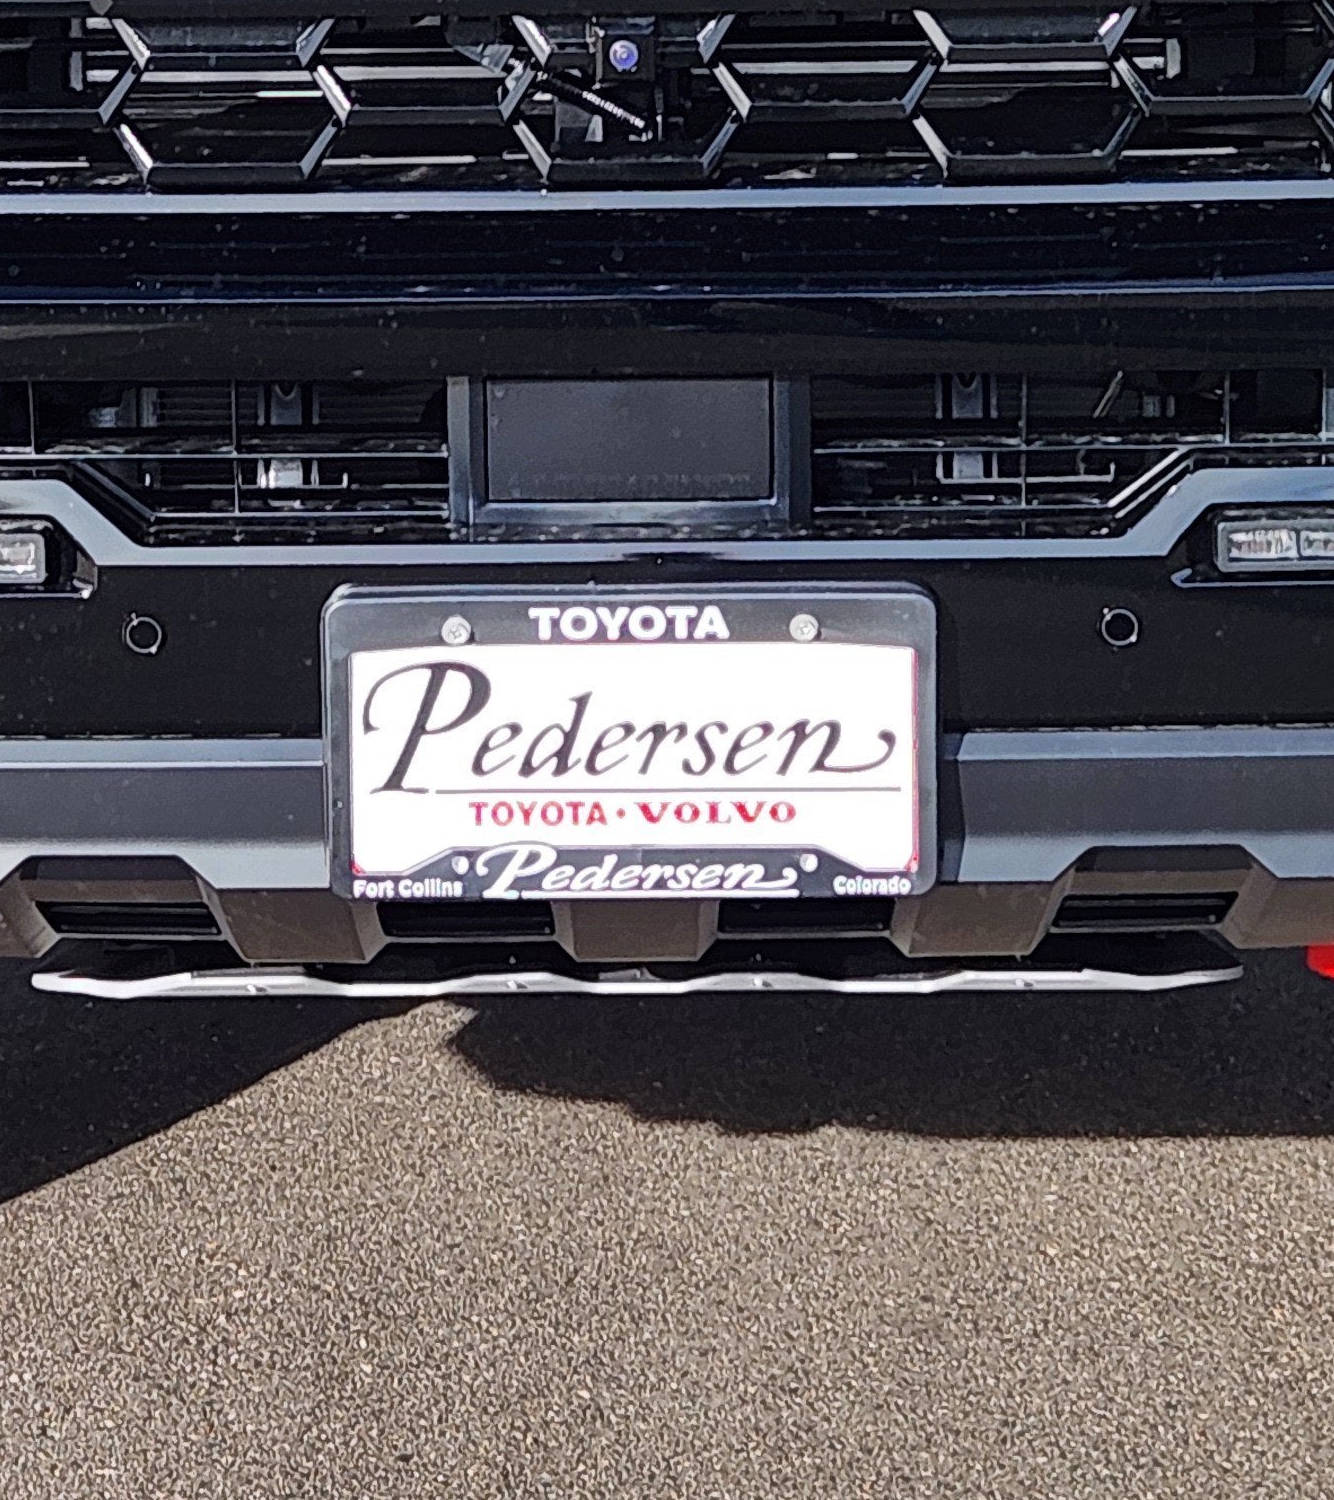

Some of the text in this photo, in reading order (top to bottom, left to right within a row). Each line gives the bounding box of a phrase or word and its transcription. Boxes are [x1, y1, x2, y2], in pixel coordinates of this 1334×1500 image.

[528, 605, 729, 641] TOYOTA
[361, 660, 896, 794] Pedersen
[468, 800, 797, 827] TOYOTA VOLVO
[475, 841, 798, 899] Pedersen
[833, 875, 912, 896] Colorado
[352, 878, 463, 899] Fort Collins
